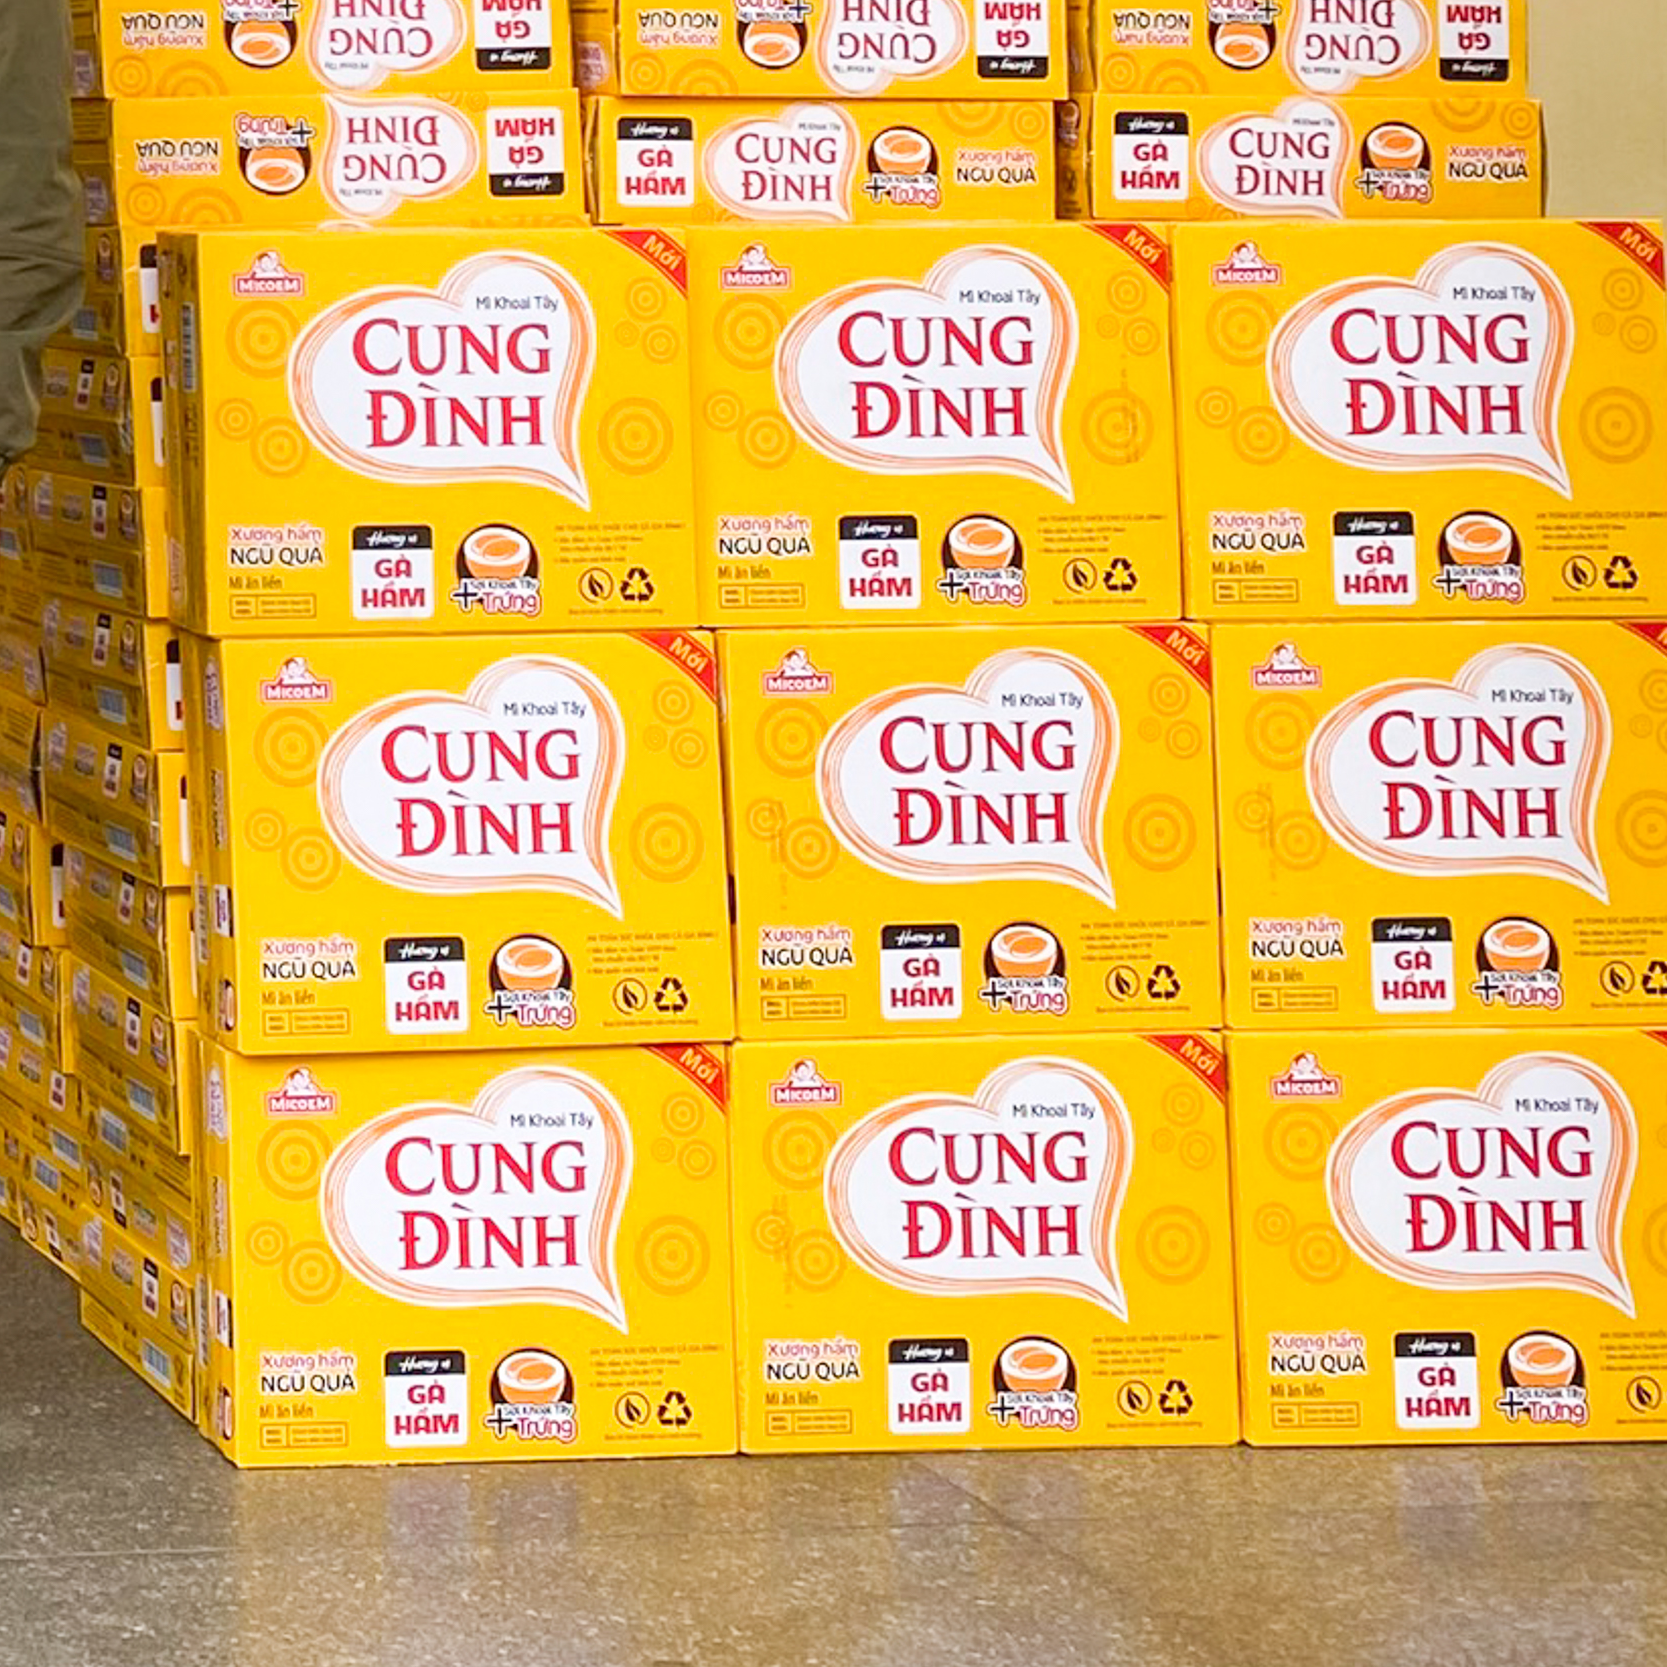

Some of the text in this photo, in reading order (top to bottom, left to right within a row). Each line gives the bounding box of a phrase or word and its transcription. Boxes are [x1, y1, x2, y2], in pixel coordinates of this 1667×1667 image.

[735, 133, 838, 165] CUNG
[742, 166, 832, 202] ĐÌNH
[642, 233, 681, 271] Mới
[1123, 230, 1162, 265] Mới
[1621, 226, 1658, 262] Mới
[352, 318, 551, 376] CUNG
[838, 311, 1035, 367] CUNG
[1330, 308, 1529, 366] CUNG
[365, 382, 547, 448] ĐÌNH
[851, 374, 1028, 440] ĐÌNH
[1345, 371, 1526, 435] ĐÌNH
[374, 553, 413, 578] GÀ
[1355, 542, 1394, 566] GÀ
[670, 637, 707, 673] Mới
[1167, 630, 1205, 664] Mới
[381, 725, 581, 784] CUNG
[880, 716, 1076, 773] CUNG
[1369, 710, 1569, 768] CUNG
[395, 789, 580, 858] ĐÌNH
[893, 779, 1070, 847] ĐÌNH
[1383, 774, 1562, 841] ĐÌNH
[679, 1049, 718, 1087] Mới
[1179, 1038, 1218, 1076] Mới
[385, 1137, 587, 1197] CUNG
[888, 1126, 1089, 1188] CUNG
[1390, 1120, 1594, 1180] CUNG
[399, 1203, 582, 1271] ĐÌNH
[901, 1192, 1083, 1260] ĐÌNH
[1405, 1185, 1590, 1254] ĐÌNH
[911, 1367, 950, 1393] GÀ
